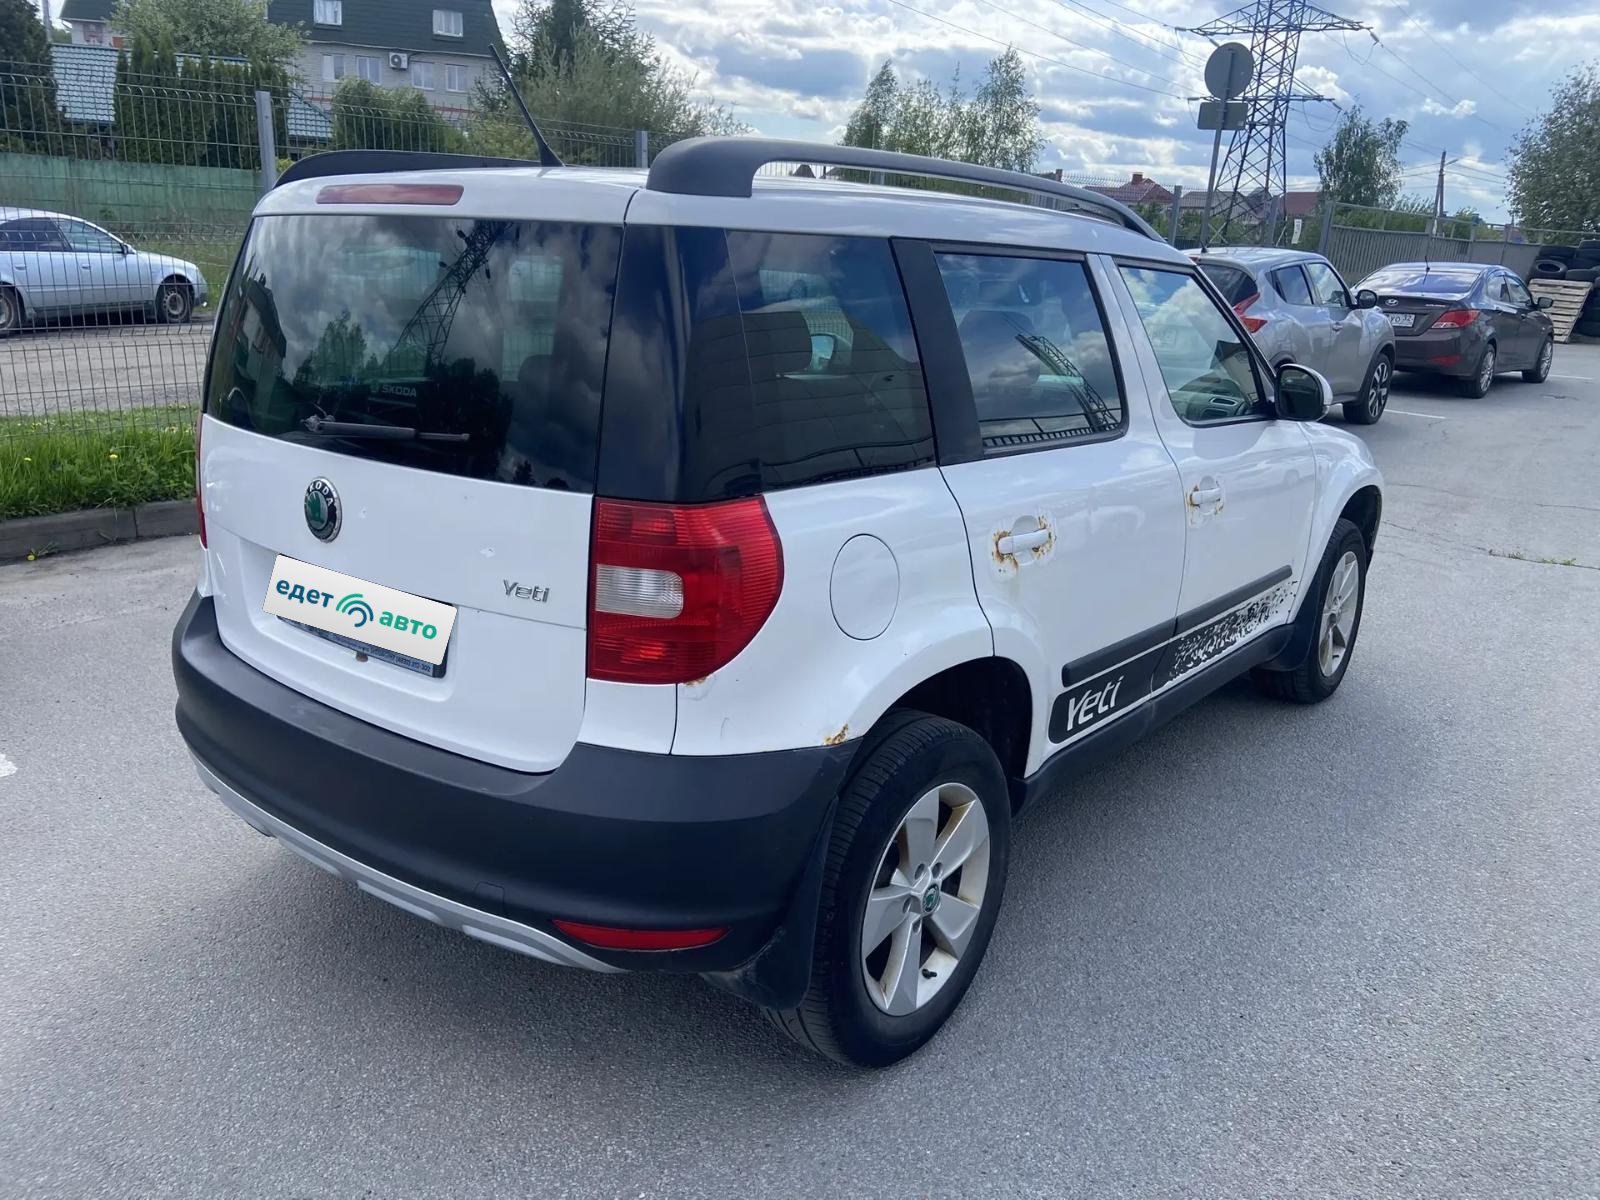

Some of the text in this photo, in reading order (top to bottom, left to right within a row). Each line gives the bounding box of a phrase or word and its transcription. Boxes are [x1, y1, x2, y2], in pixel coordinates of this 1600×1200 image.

[382, 384, 417, 397] SKODA
[503, 579, 550, 603] Yeti
[1066, 675, 1124, 732] Yeti
